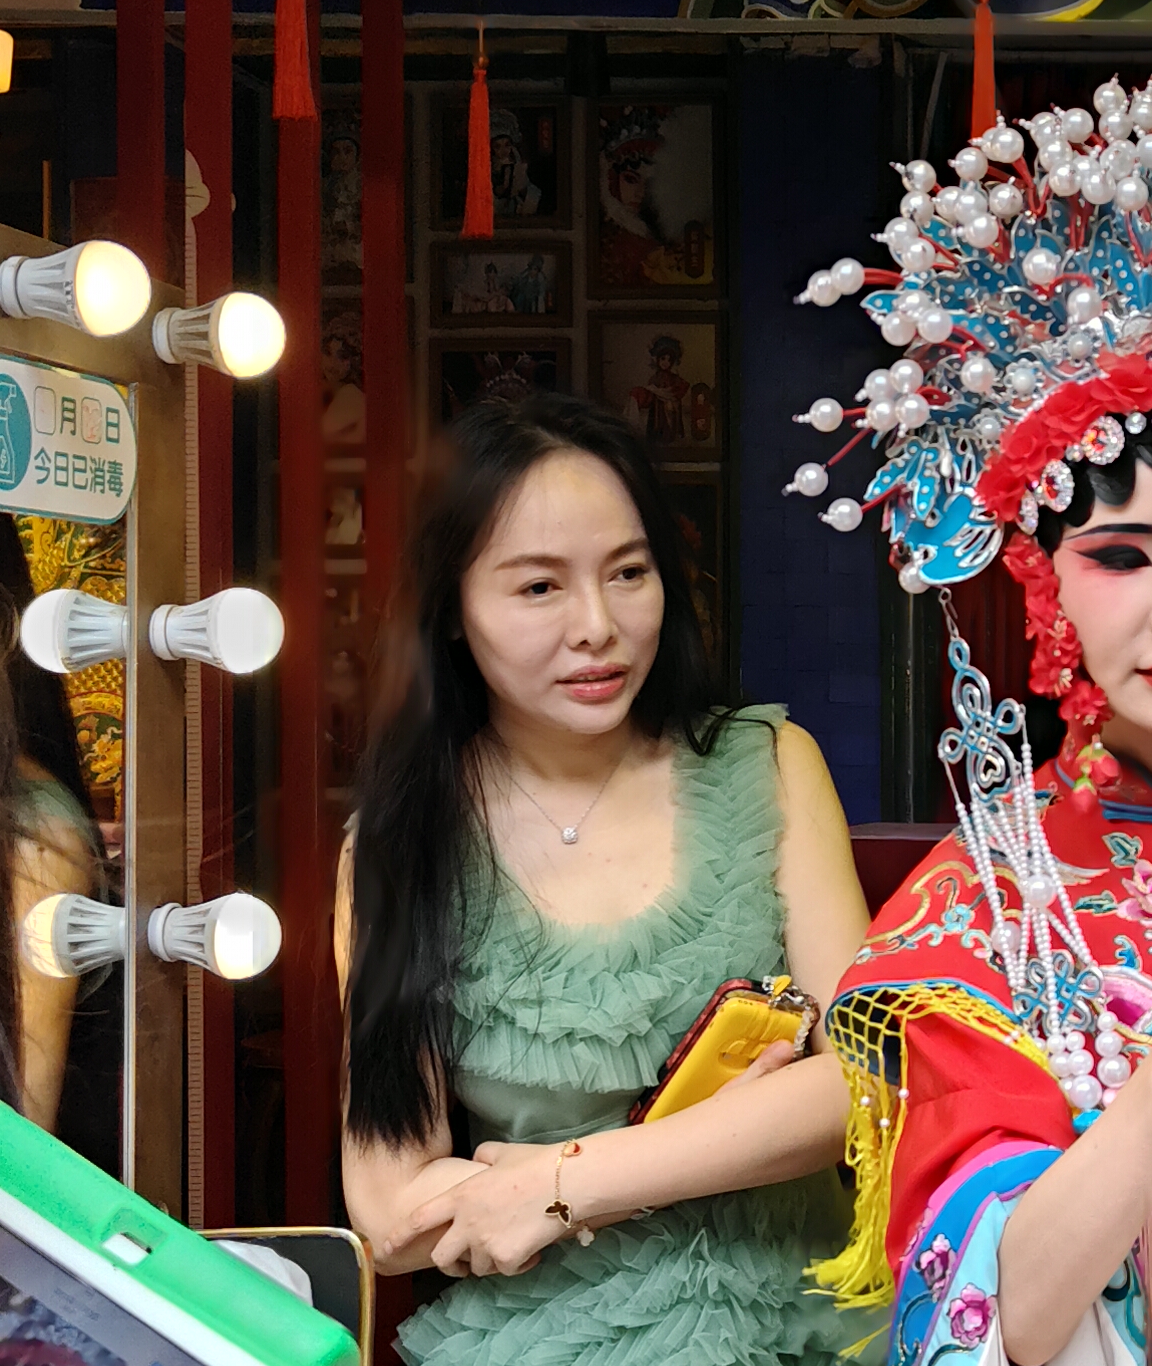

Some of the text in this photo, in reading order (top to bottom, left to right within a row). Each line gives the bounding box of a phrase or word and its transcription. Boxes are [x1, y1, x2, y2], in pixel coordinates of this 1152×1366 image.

[34, 446, 124, 498] 今日已消毒
